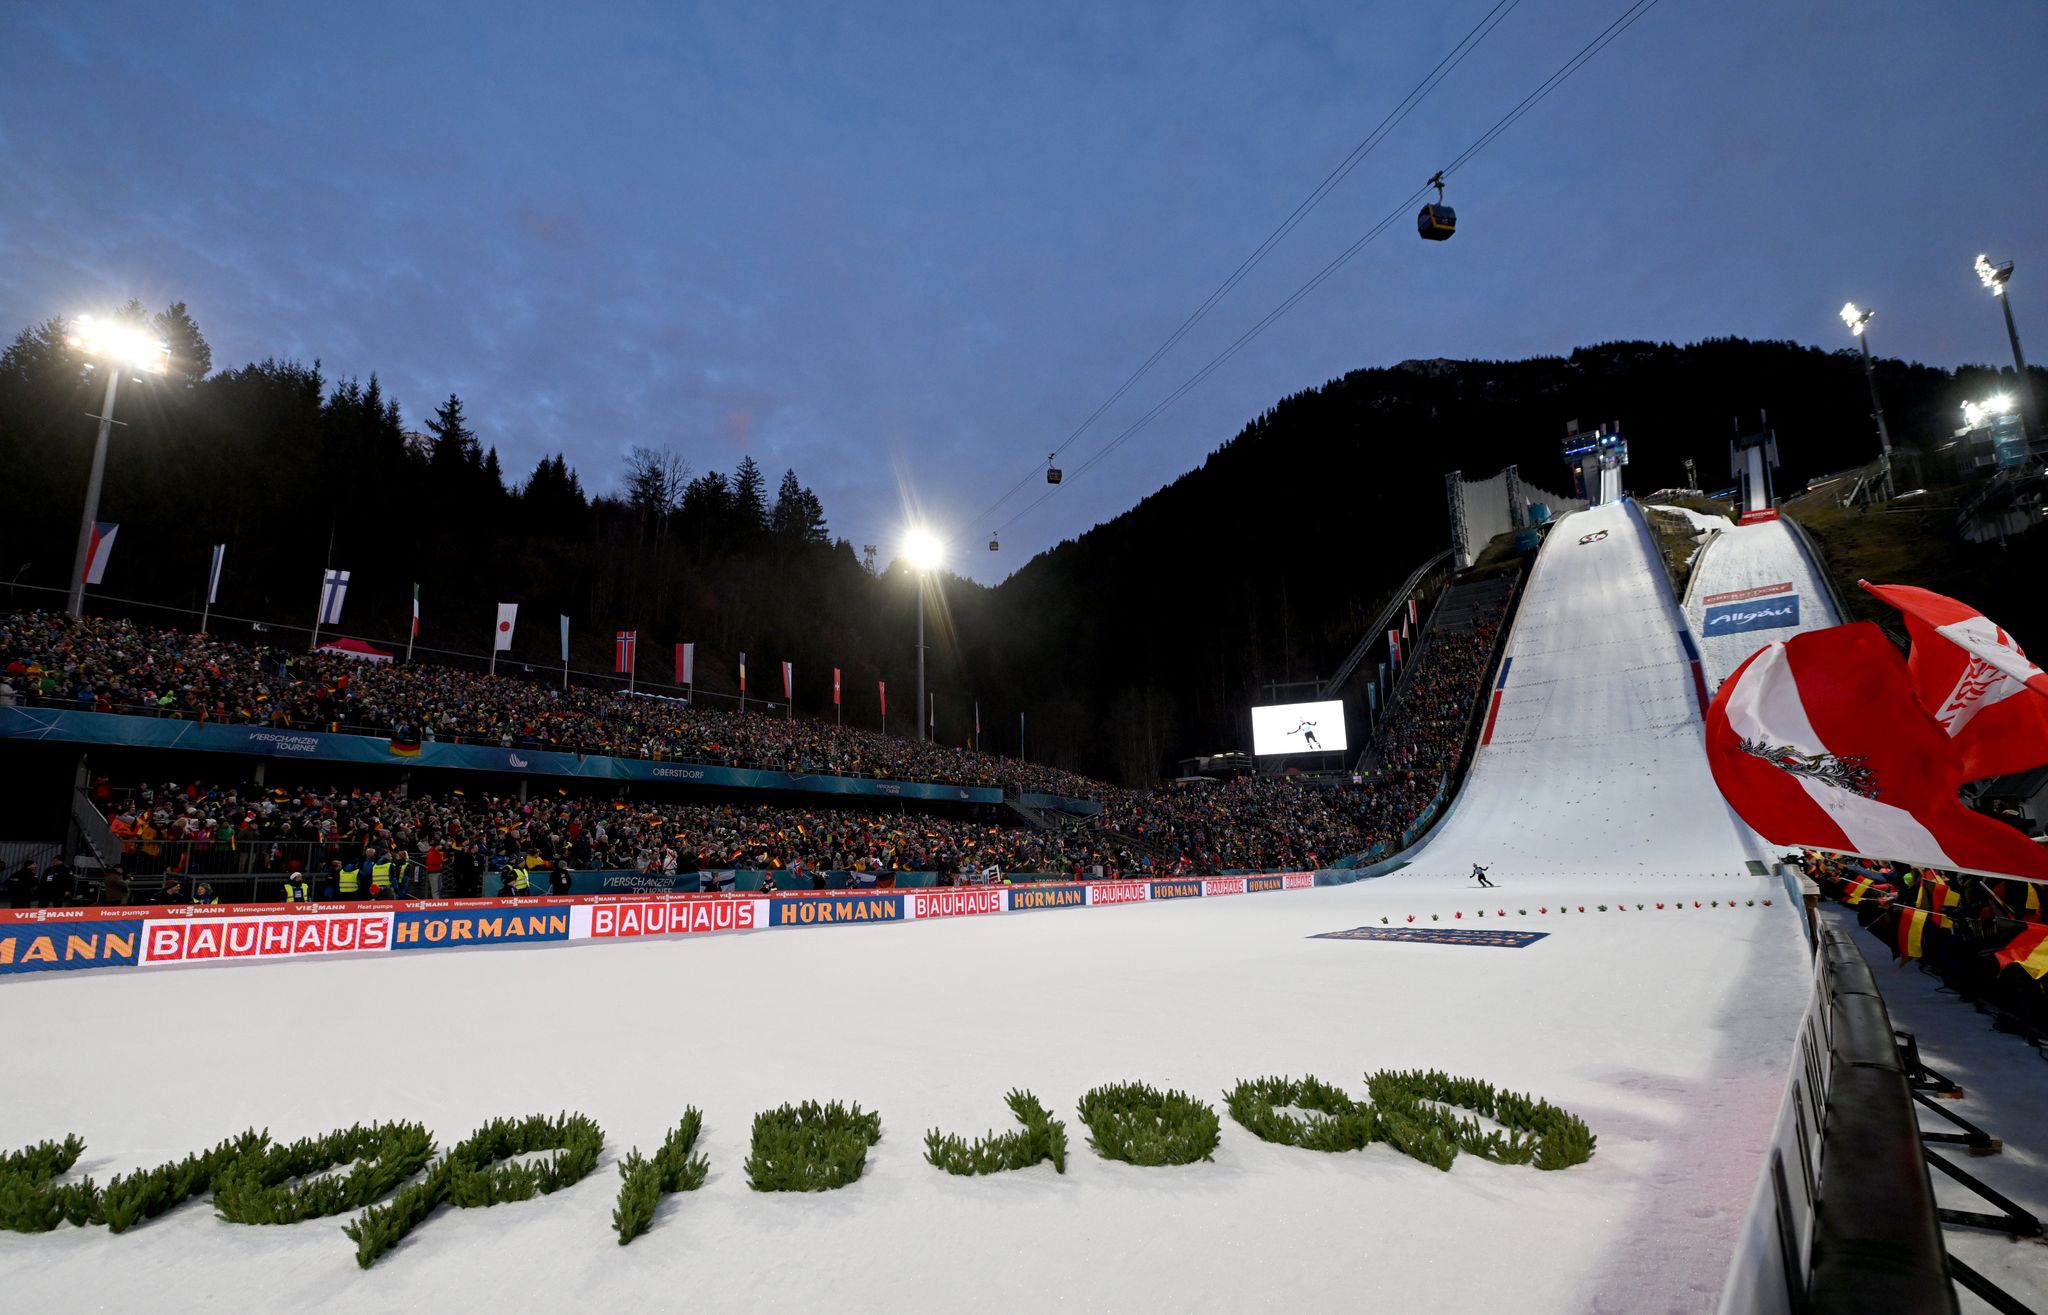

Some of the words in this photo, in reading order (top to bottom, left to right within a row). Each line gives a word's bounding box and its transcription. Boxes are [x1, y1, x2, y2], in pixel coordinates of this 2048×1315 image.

[1710, 605, 1793, 625] Allgäu
[249, 733, 319, 745] VIERSCHANZEN
[276, 742, 317, 752] TOURNEE
[652, 767, 705, 779] OBERSTDORF
[603, 876, 677, 887] VIERSCHANZEN
[1206, 881, 1244, 895] BAUHAUS
[1249, 879, 1281, 891] HÖRMANN
[1285, 876, 1313, 888] BAUHAUS
[1014, 890, 1081, 908] HÖRMANN
[1093, 884, 1146, 902] BAUHAUS
[1154, 884, 1199, 898] HÖRMANN
[15, 909, 84, 922] VIESSMANN
[122, 909, 150, 918] pumps
[167, 906, 226, 917] VIESSMANN
[232, 906, 286, 914] Wärmepumpen
[295, 903, 346, 913] VIESSMANN
[373, 903, 394, 911] pumps
[405, 900, 449, 910] VIESSMANN
[500, 897, 539, 907] VIESSMANN
[584, 895, 617, 904] VIESSMANN
[781, 901, 896, 924] HÖRMANN
[917, 892, 999, 915] BAUHAUS
[595, 903, 753, 933] BAUHAUS
[153, 920, 386, 955] BAUHAUS
[396, 915, 567, 944] HÖRMANN
